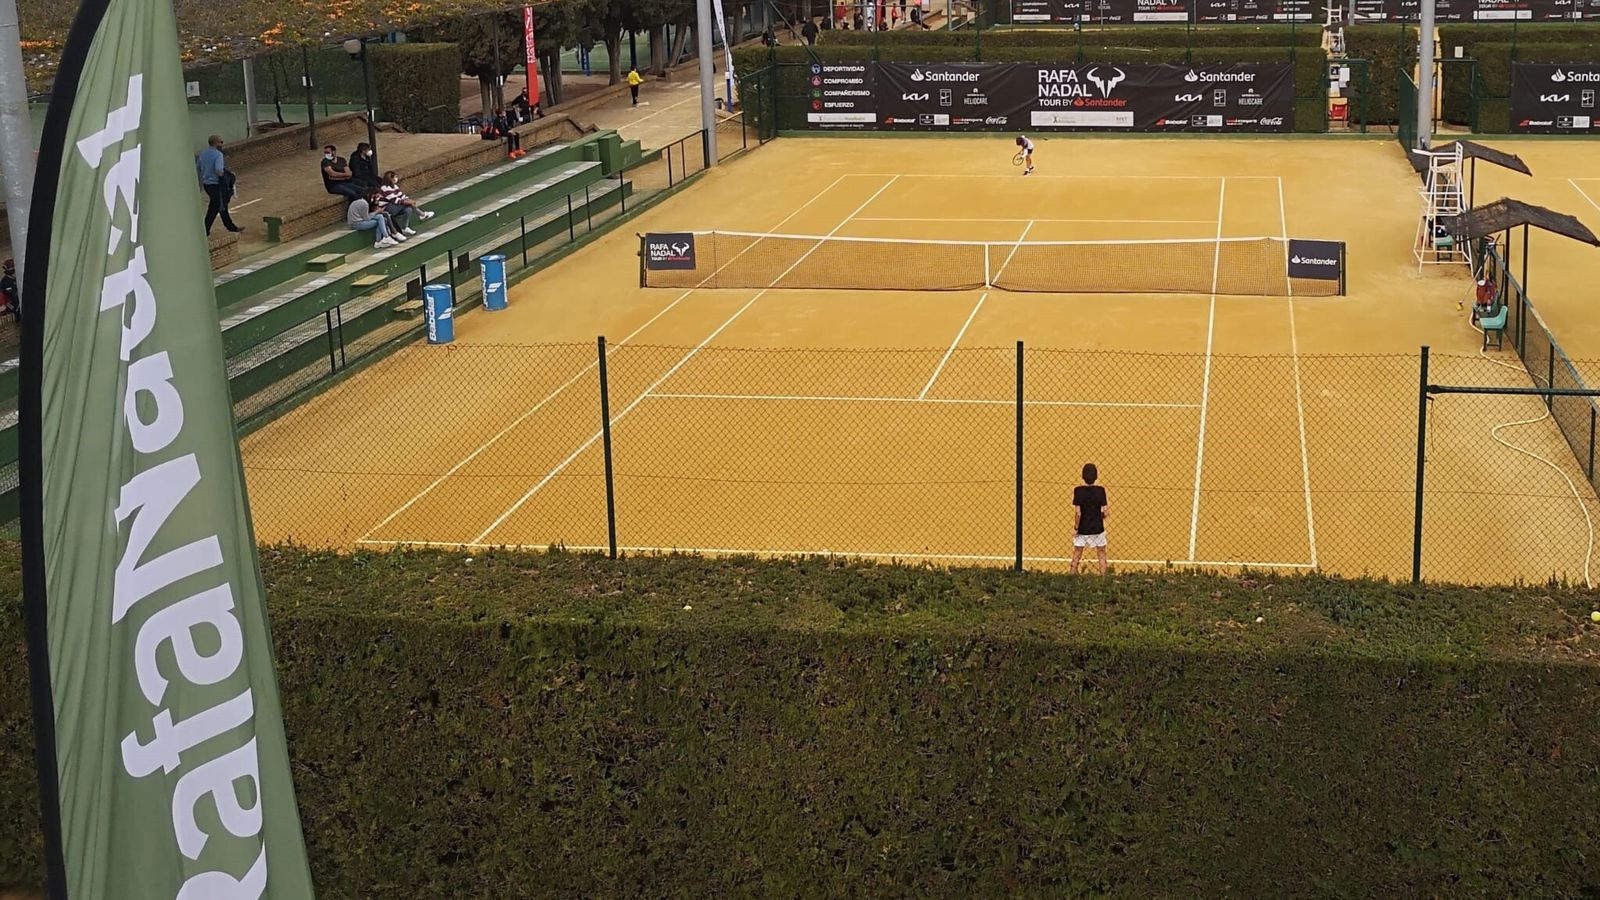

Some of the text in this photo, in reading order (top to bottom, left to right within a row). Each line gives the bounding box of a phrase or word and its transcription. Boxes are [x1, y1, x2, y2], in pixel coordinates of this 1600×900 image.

[925, 71, 980, 81] Santander
[1038, 69, 1078, 83] RAFA
[1200, 71, 1256, 82] Santander
[1038, 83, 1093, 97] NADAL
[1039, 97, 1127, 106] TOUR BY Santander
[1301, 257, 1337, 266] Santander
[426, 293, 437, 342] Babolat
